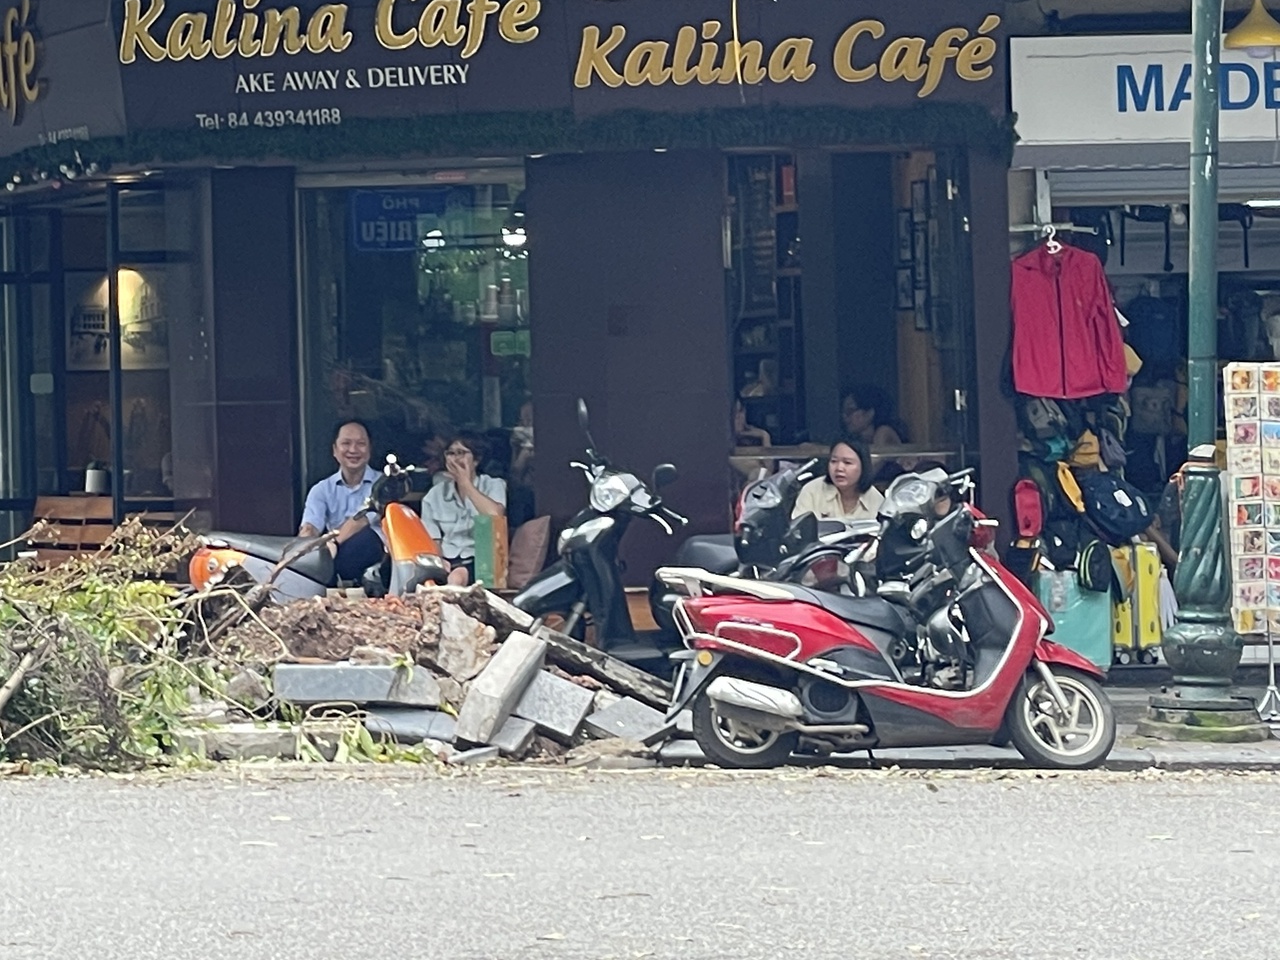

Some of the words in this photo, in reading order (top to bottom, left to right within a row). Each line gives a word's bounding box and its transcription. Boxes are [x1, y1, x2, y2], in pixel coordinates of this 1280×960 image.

[573, 21, 816, 88] Kalina
[832, 15, 1000, 98] Café
[235, 72, 276, 93] AKE
[282, 69, 340, 91] AWAY
[345, 69, 361, 89] &
[367, 64, 470, 88] DELIVERY
[228, 112, 250, 128] 84
[254, 108, 341, 127] 439341188
